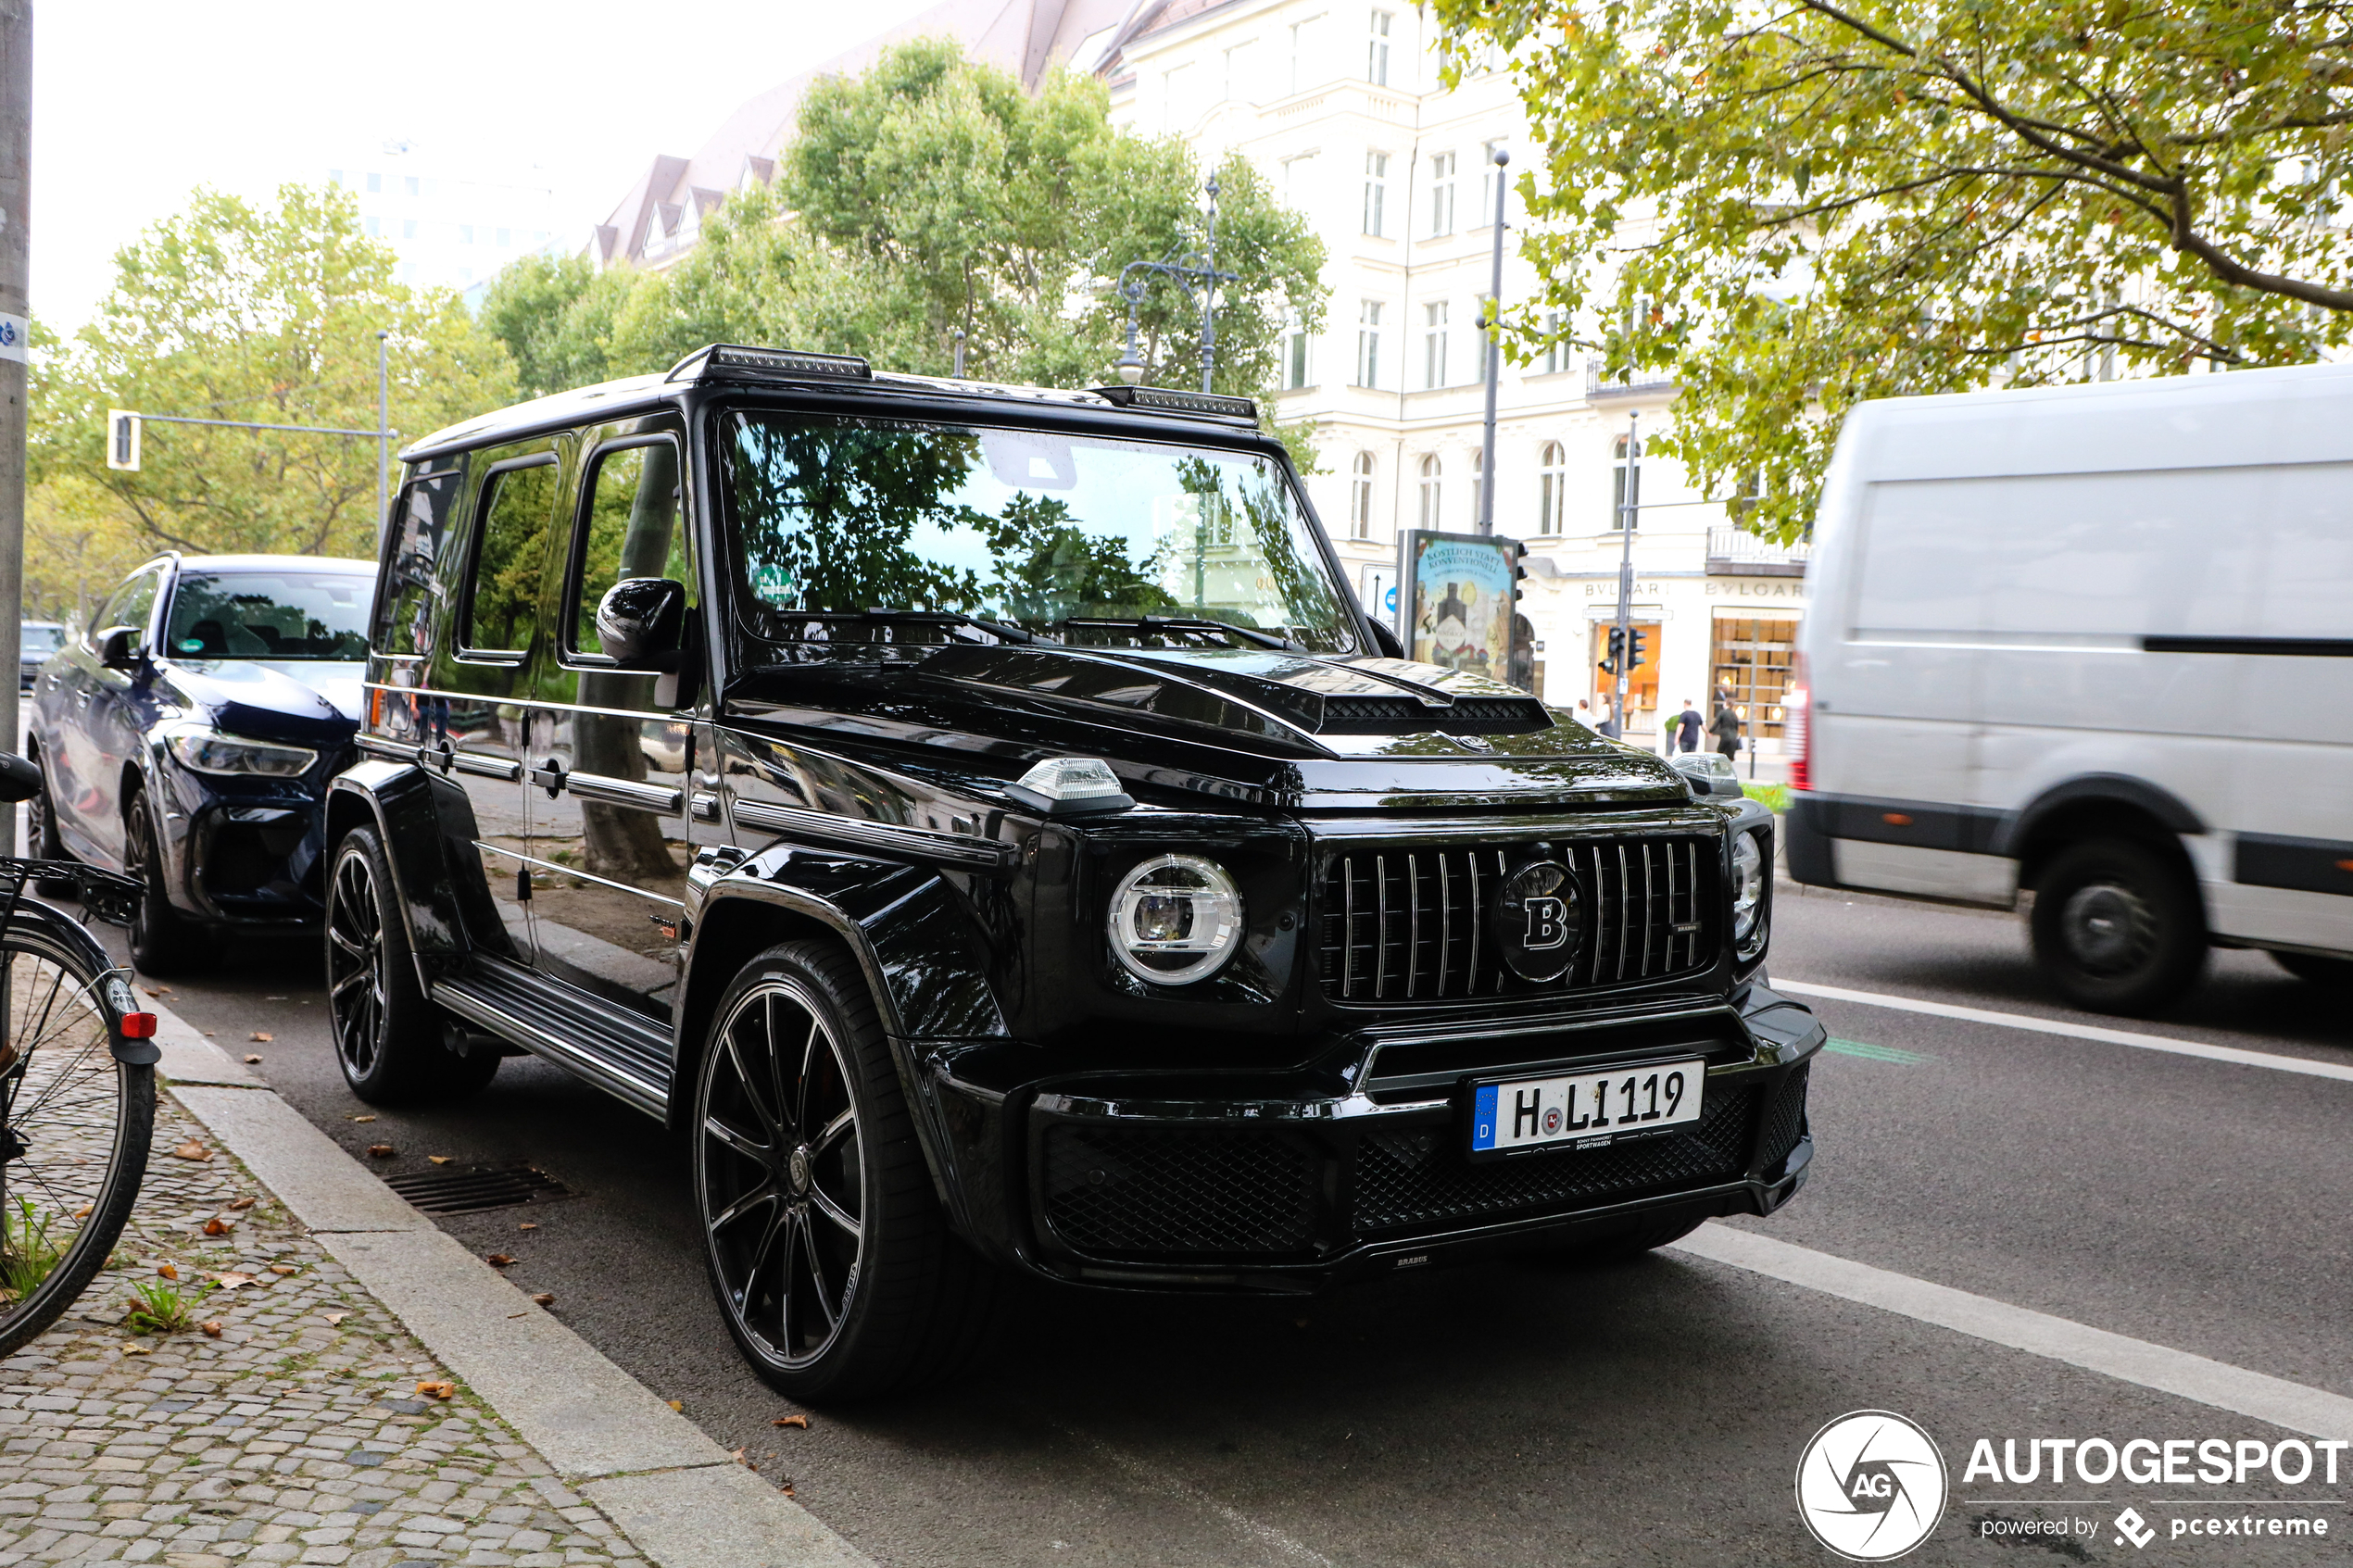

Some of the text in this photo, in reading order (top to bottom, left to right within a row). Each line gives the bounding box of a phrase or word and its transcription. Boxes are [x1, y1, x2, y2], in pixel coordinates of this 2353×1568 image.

[1585, 583, 1670, 596] BVLARI
[1705, 583, 1805, 596] BVLGAR
[1514, 1087, 1541, 1138] H
[1618, 1071, 1684, 1124] 119
[1479, 1124, 1489, 1138] D
[1577, 1140, 1611, 1150] SPORTWAGEN
[1397, 1255, 1428, 1266] BRABUS
[842, 1264, 857, 1307] BRABUS
